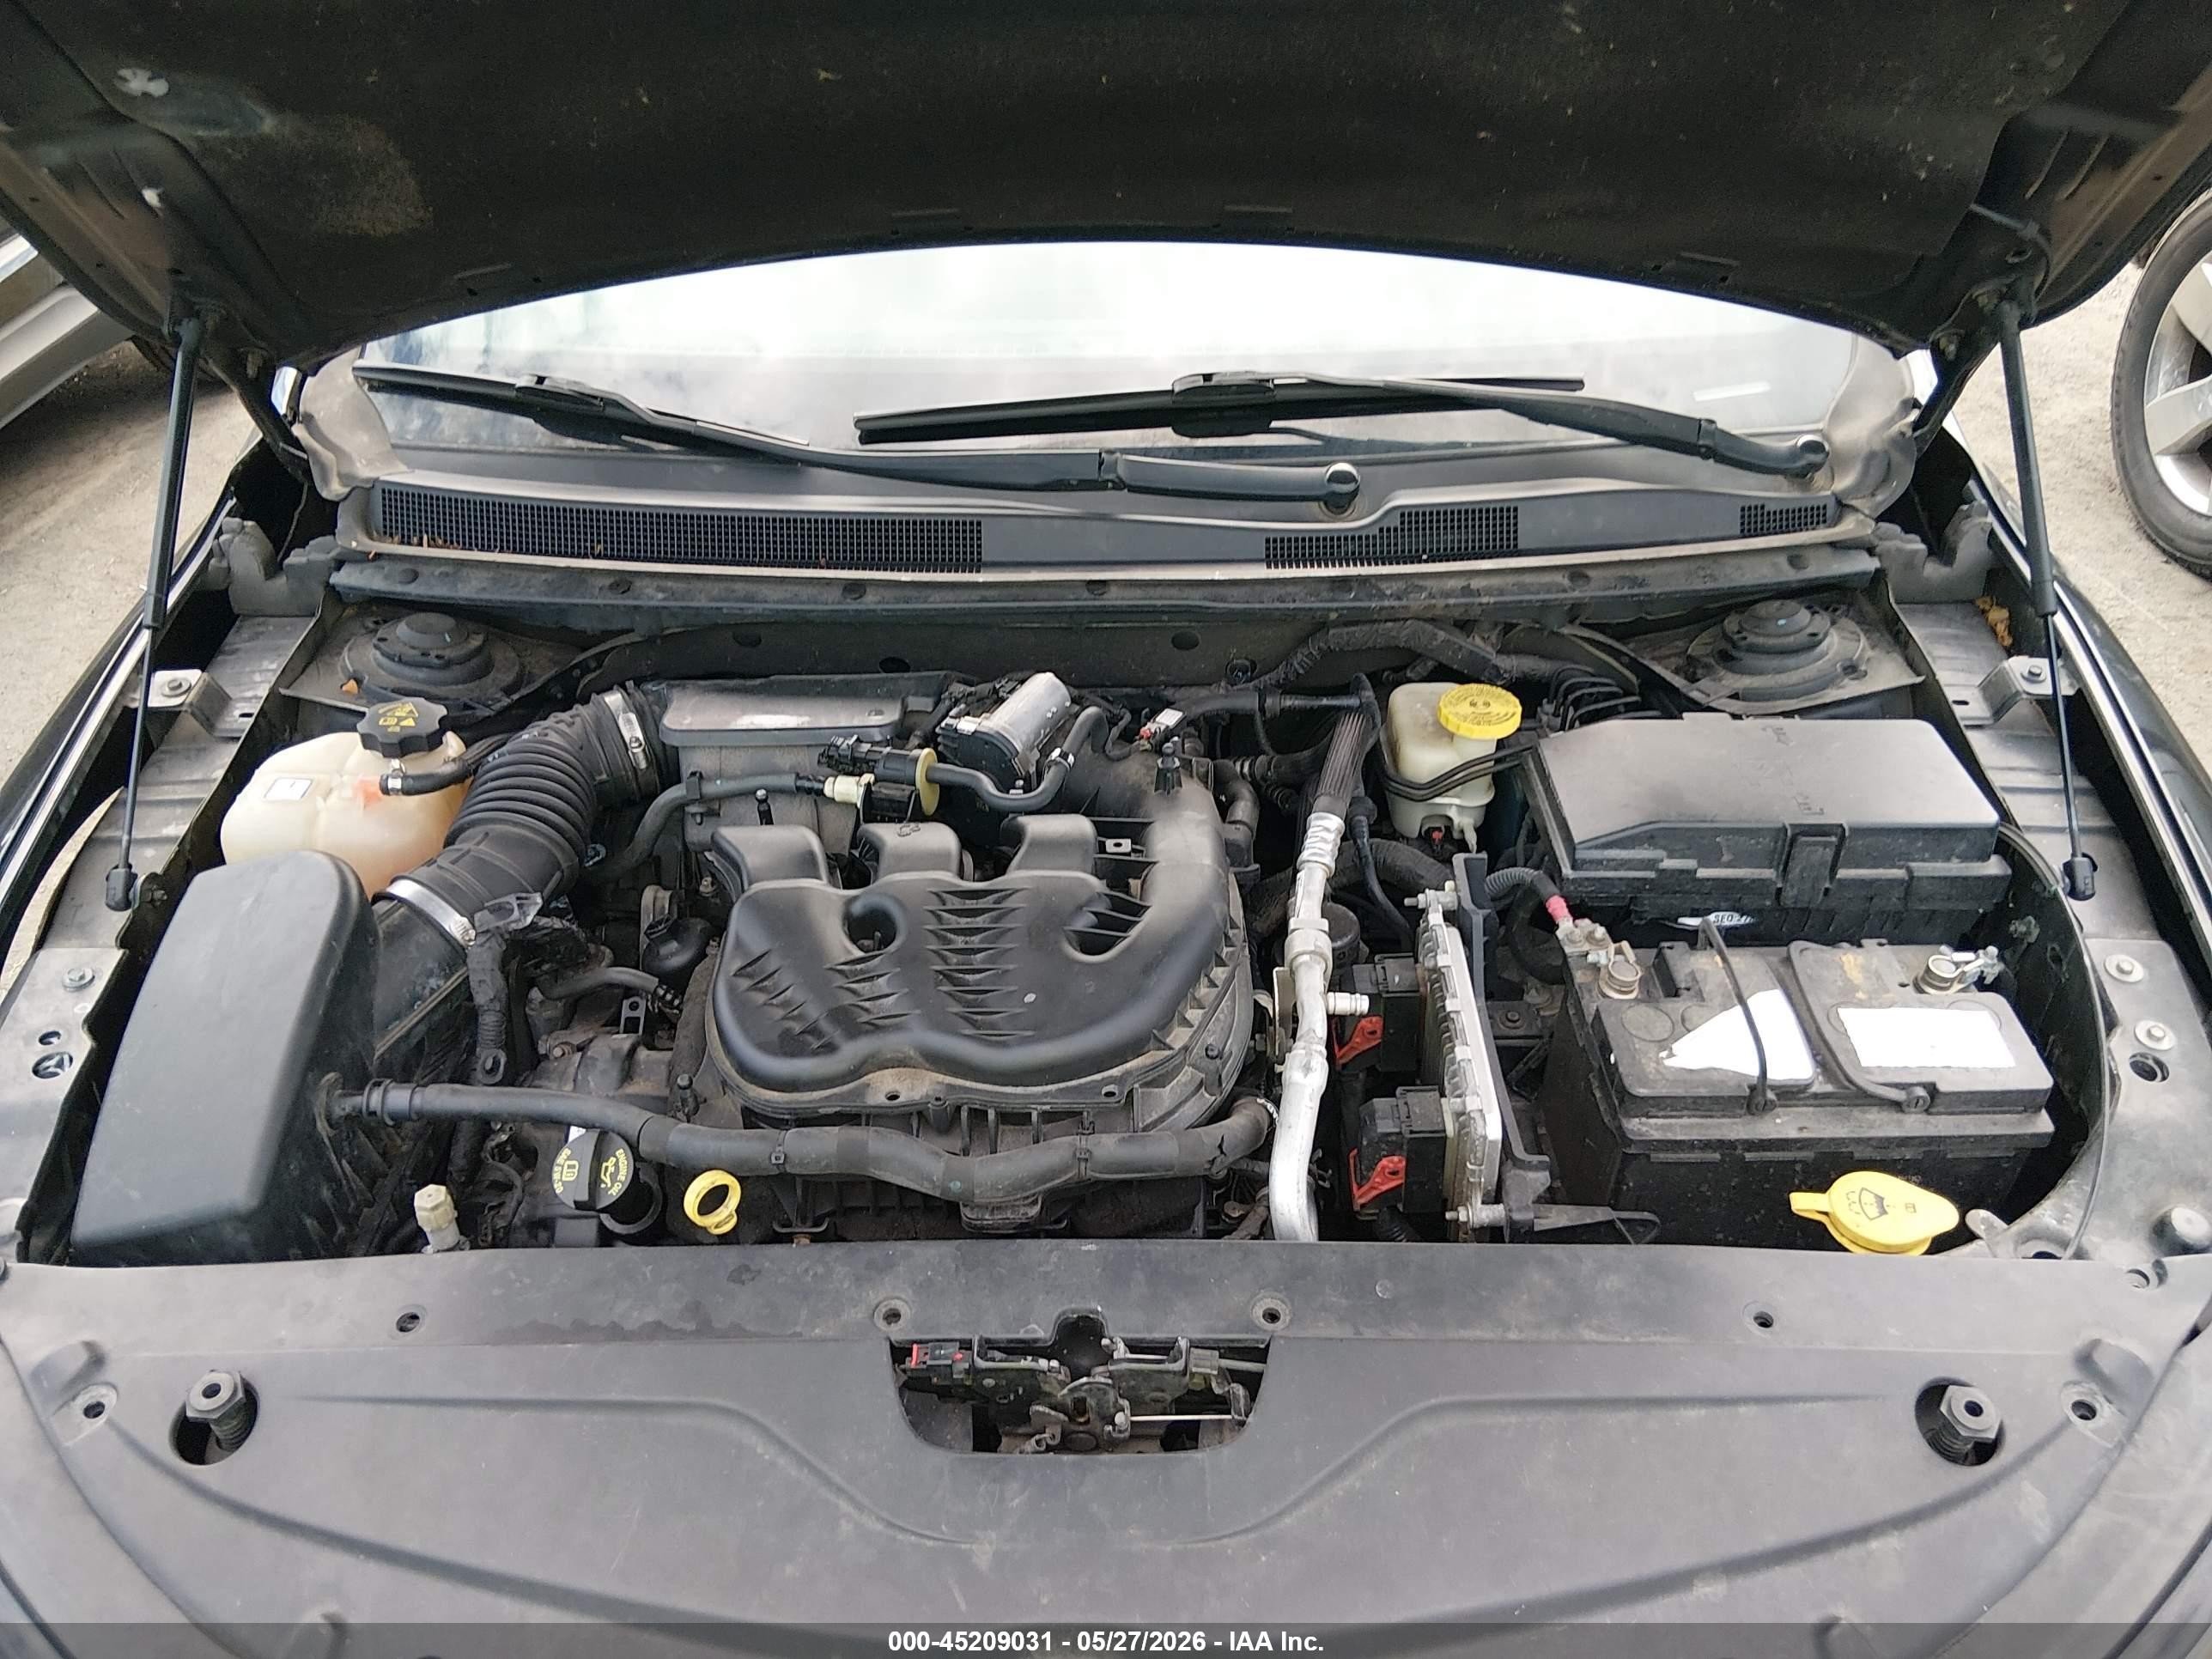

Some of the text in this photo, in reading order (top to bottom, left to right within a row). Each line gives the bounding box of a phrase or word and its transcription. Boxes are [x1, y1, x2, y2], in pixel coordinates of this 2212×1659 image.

[556, 1147, 571, 1165] SAE
[608, 1148, 628, 1196] ENGINE OIL
